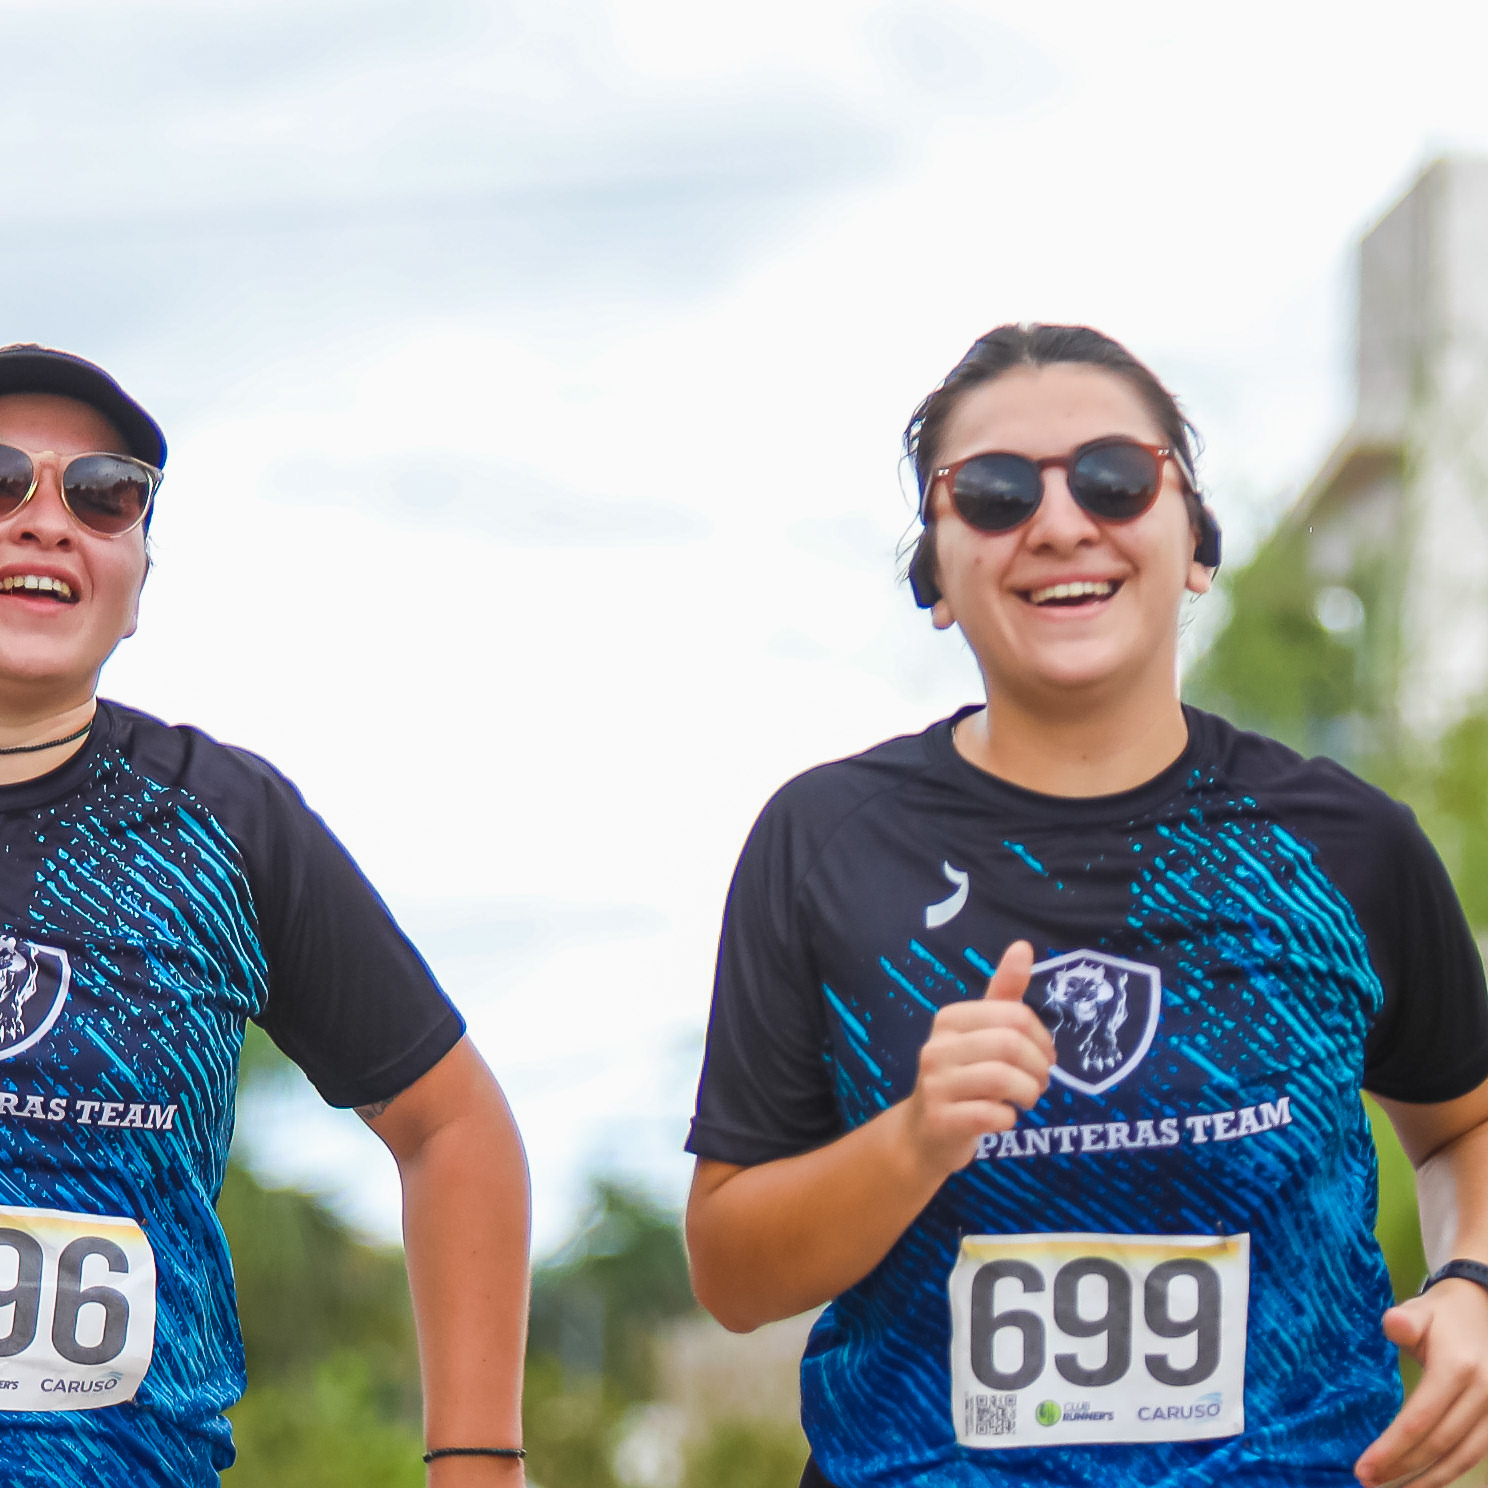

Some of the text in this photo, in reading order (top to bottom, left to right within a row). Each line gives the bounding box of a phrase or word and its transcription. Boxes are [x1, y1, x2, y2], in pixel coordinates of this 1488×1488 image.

[75, 1099, 178, 1130] TEAM
[975, 1096, 1292, 1160] PANTERAS TEAM
[970, 1255, 1223, 1392] 699
[40, 1377, 119, 1393] CARUSO
[1063, 1401, 1091, 1412] CLUB
[1137, 1402, 1222, 1422] CARUSO
